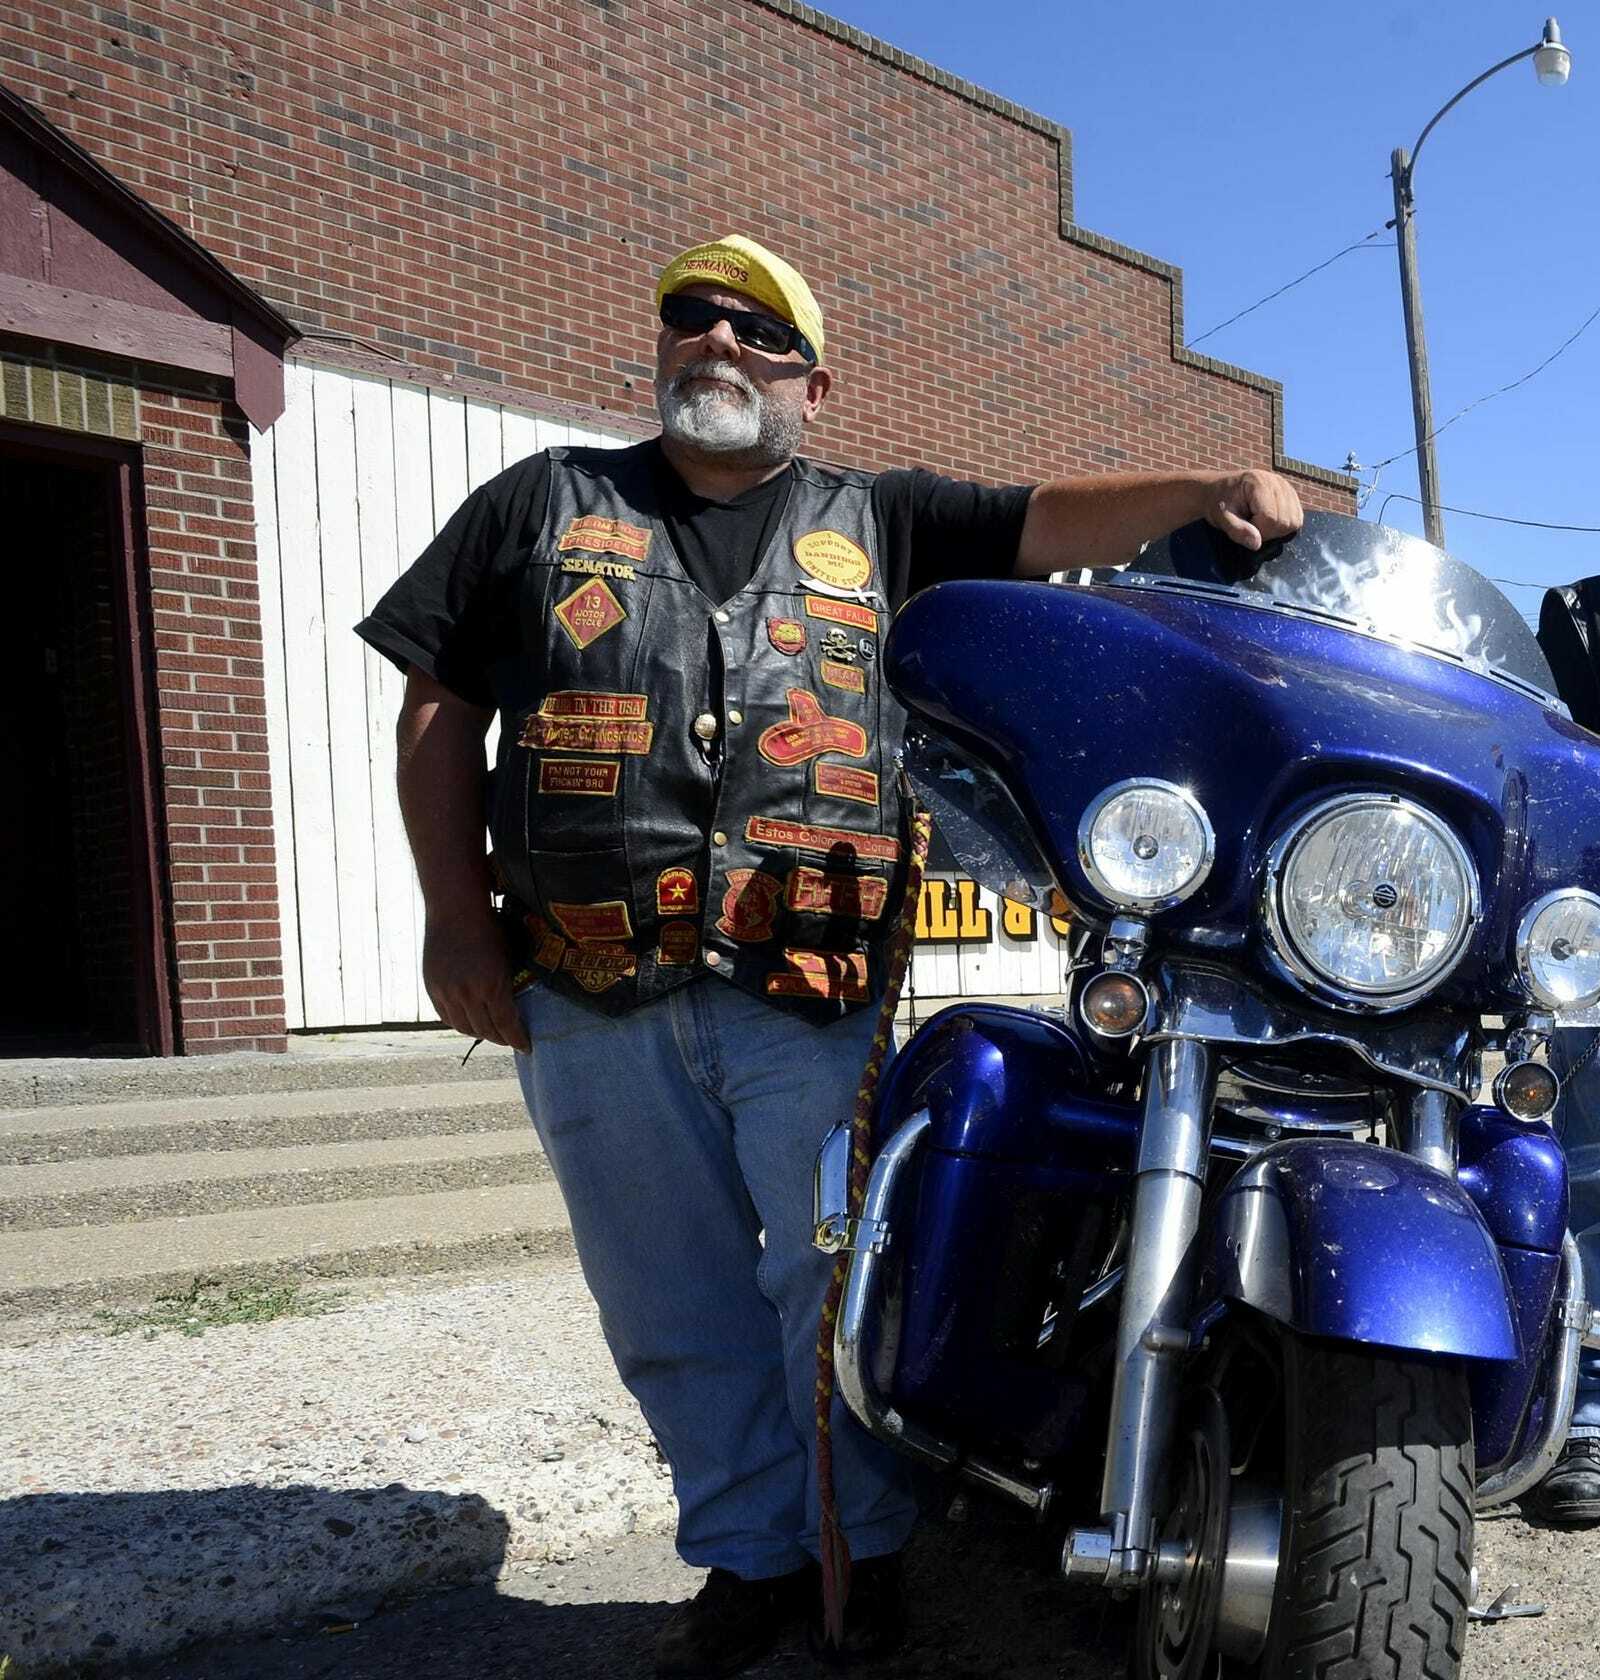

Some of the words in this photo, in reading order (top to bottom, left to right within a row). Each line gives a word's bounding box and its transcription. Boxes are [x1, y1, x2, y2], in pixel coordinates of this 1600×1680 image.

[683, 259, 749, 282] HERMANOS
[566, 535, 644, 557] PRESIDENT
[561, 558, 636, 581] SENATOR
[584, 595, 601, 609] 13
[575, 618, 602, 627] CYCLE
[812, 602, 844, 618] GREAT
[846, 609, 873, 625] FALLS
[592, 699, 615, 714] THE
[618, 700, 642, 715] USA
[584, 767, 609, 777] YOUR
[755, 824, 794, 840] Estos
[863, 840, 896, 856] Corren
